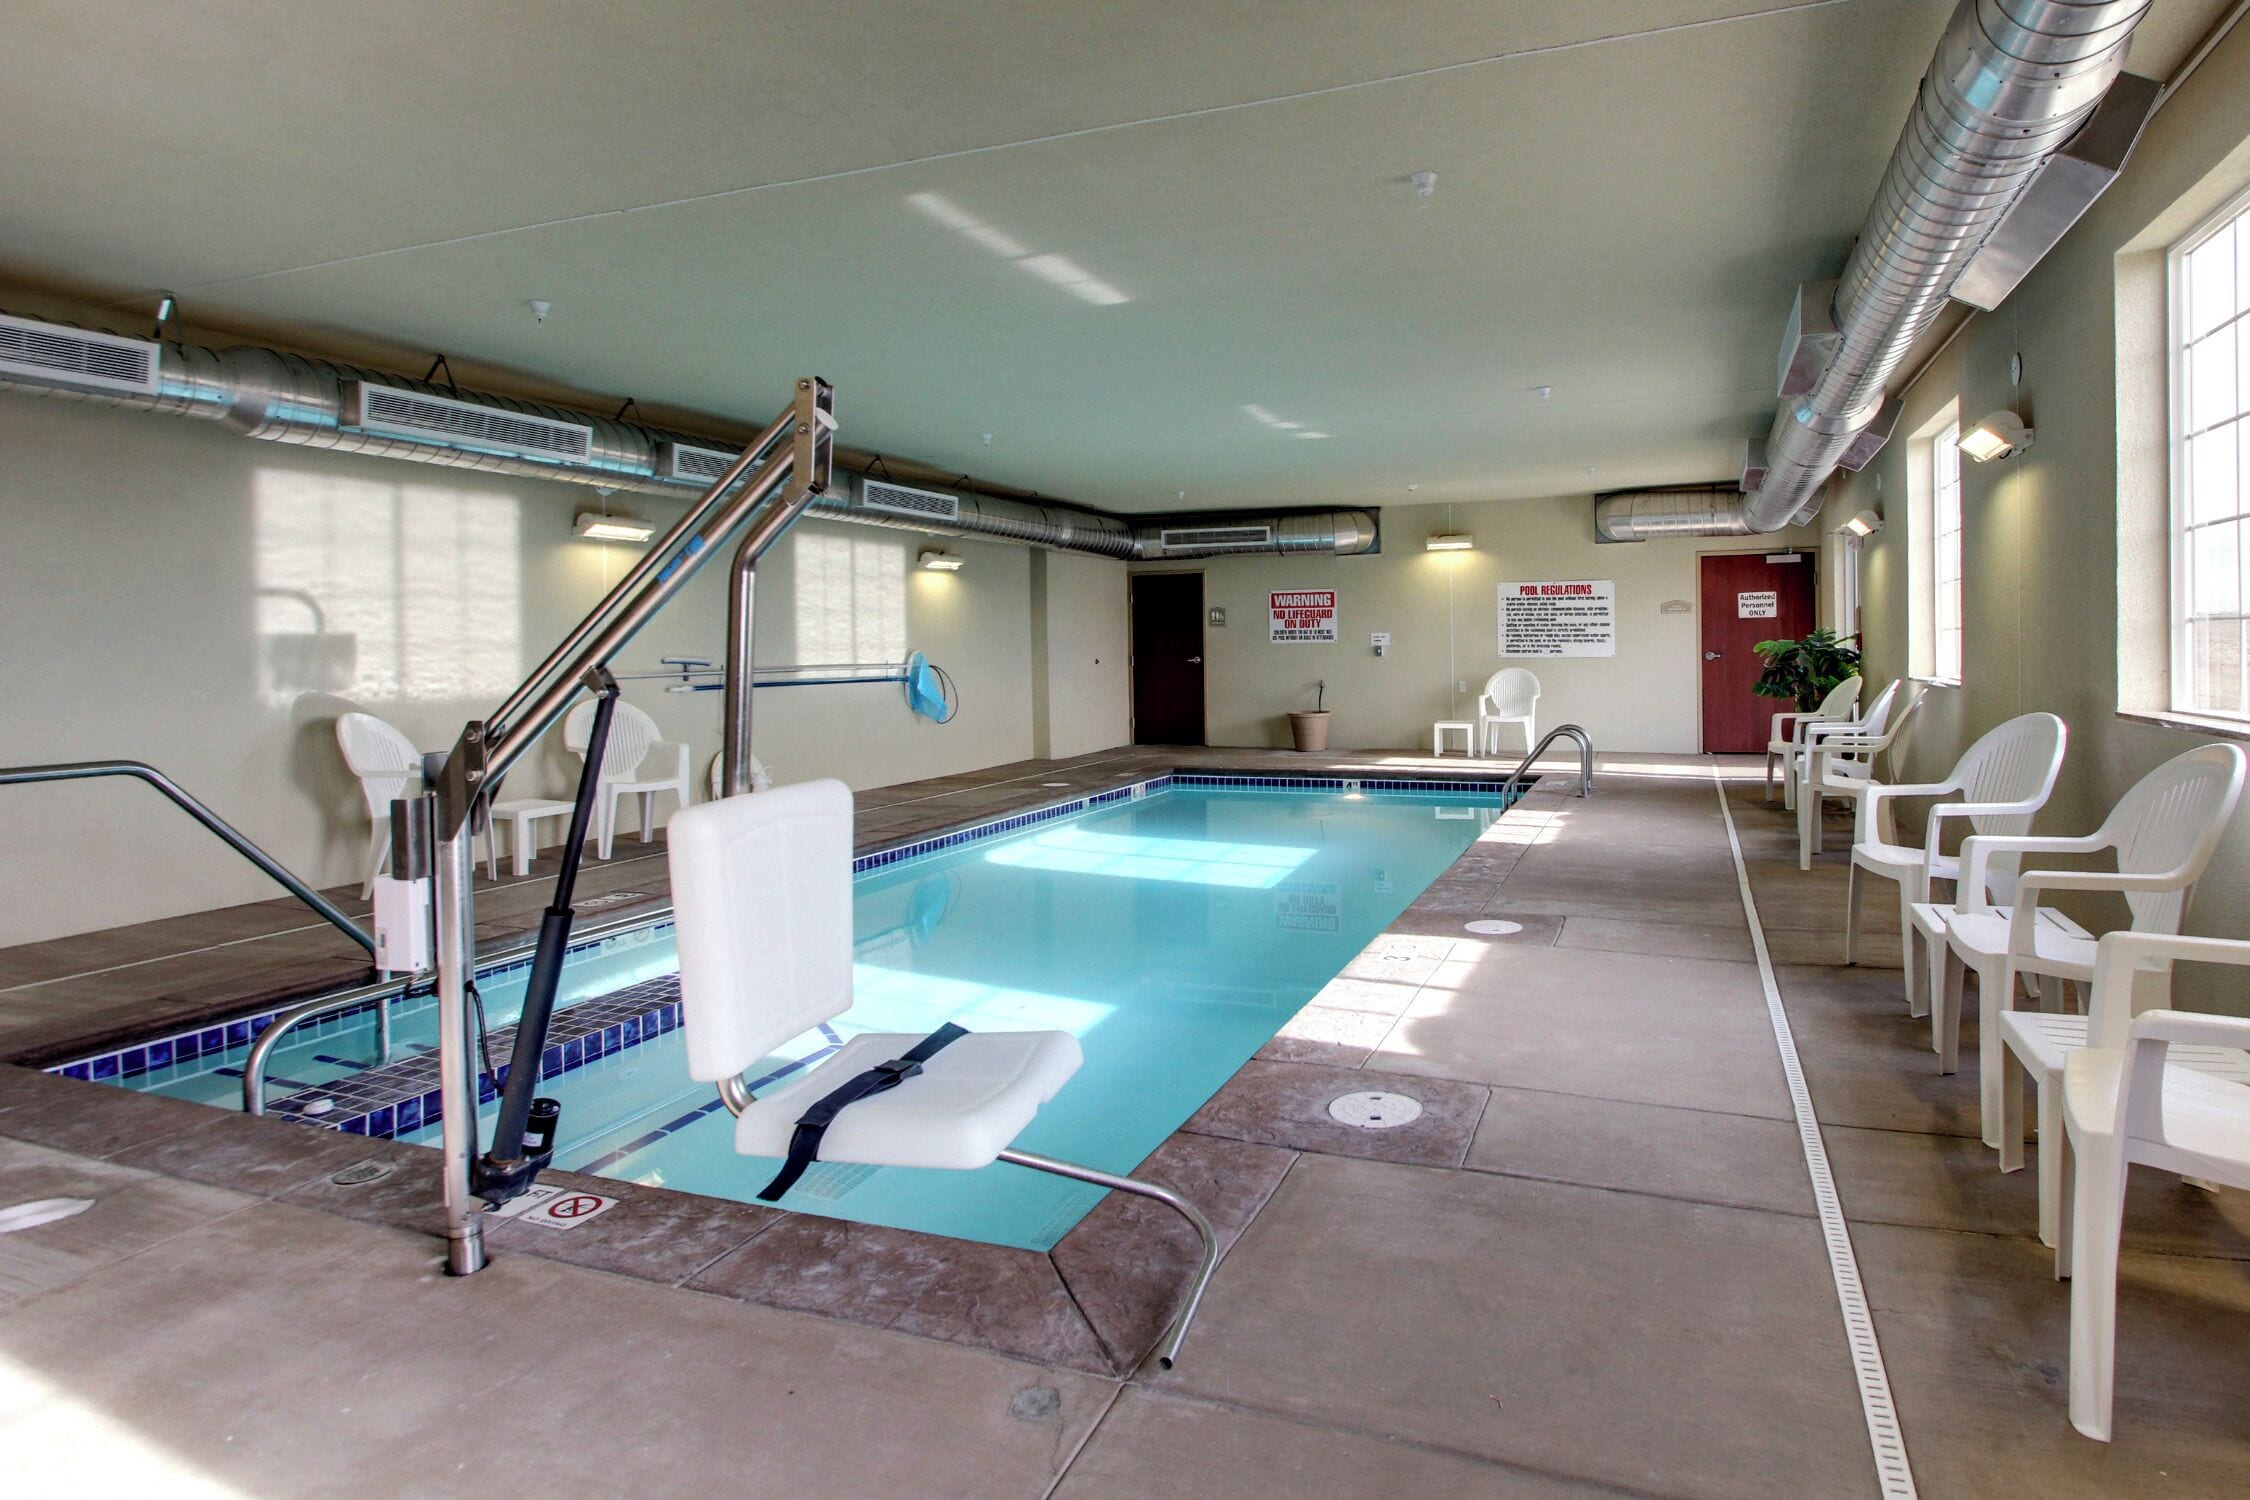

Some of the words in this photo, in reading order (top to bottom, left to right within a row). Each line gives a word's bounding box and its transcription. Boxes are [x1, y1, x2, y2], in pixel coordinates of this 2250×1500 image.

[1520, 585, 1538, 595] POOL
[1541, 584, 1592, 596] REGULATIONS
[1274, 593, 1331, 607] WARNING
[1273, 609, 1285, 619] NO
[1288, 609, 1332, 619] LIFEGUARD
[1284, 619, 1296, 629] ON
[1299, 619, 1321, 628] DUTY
